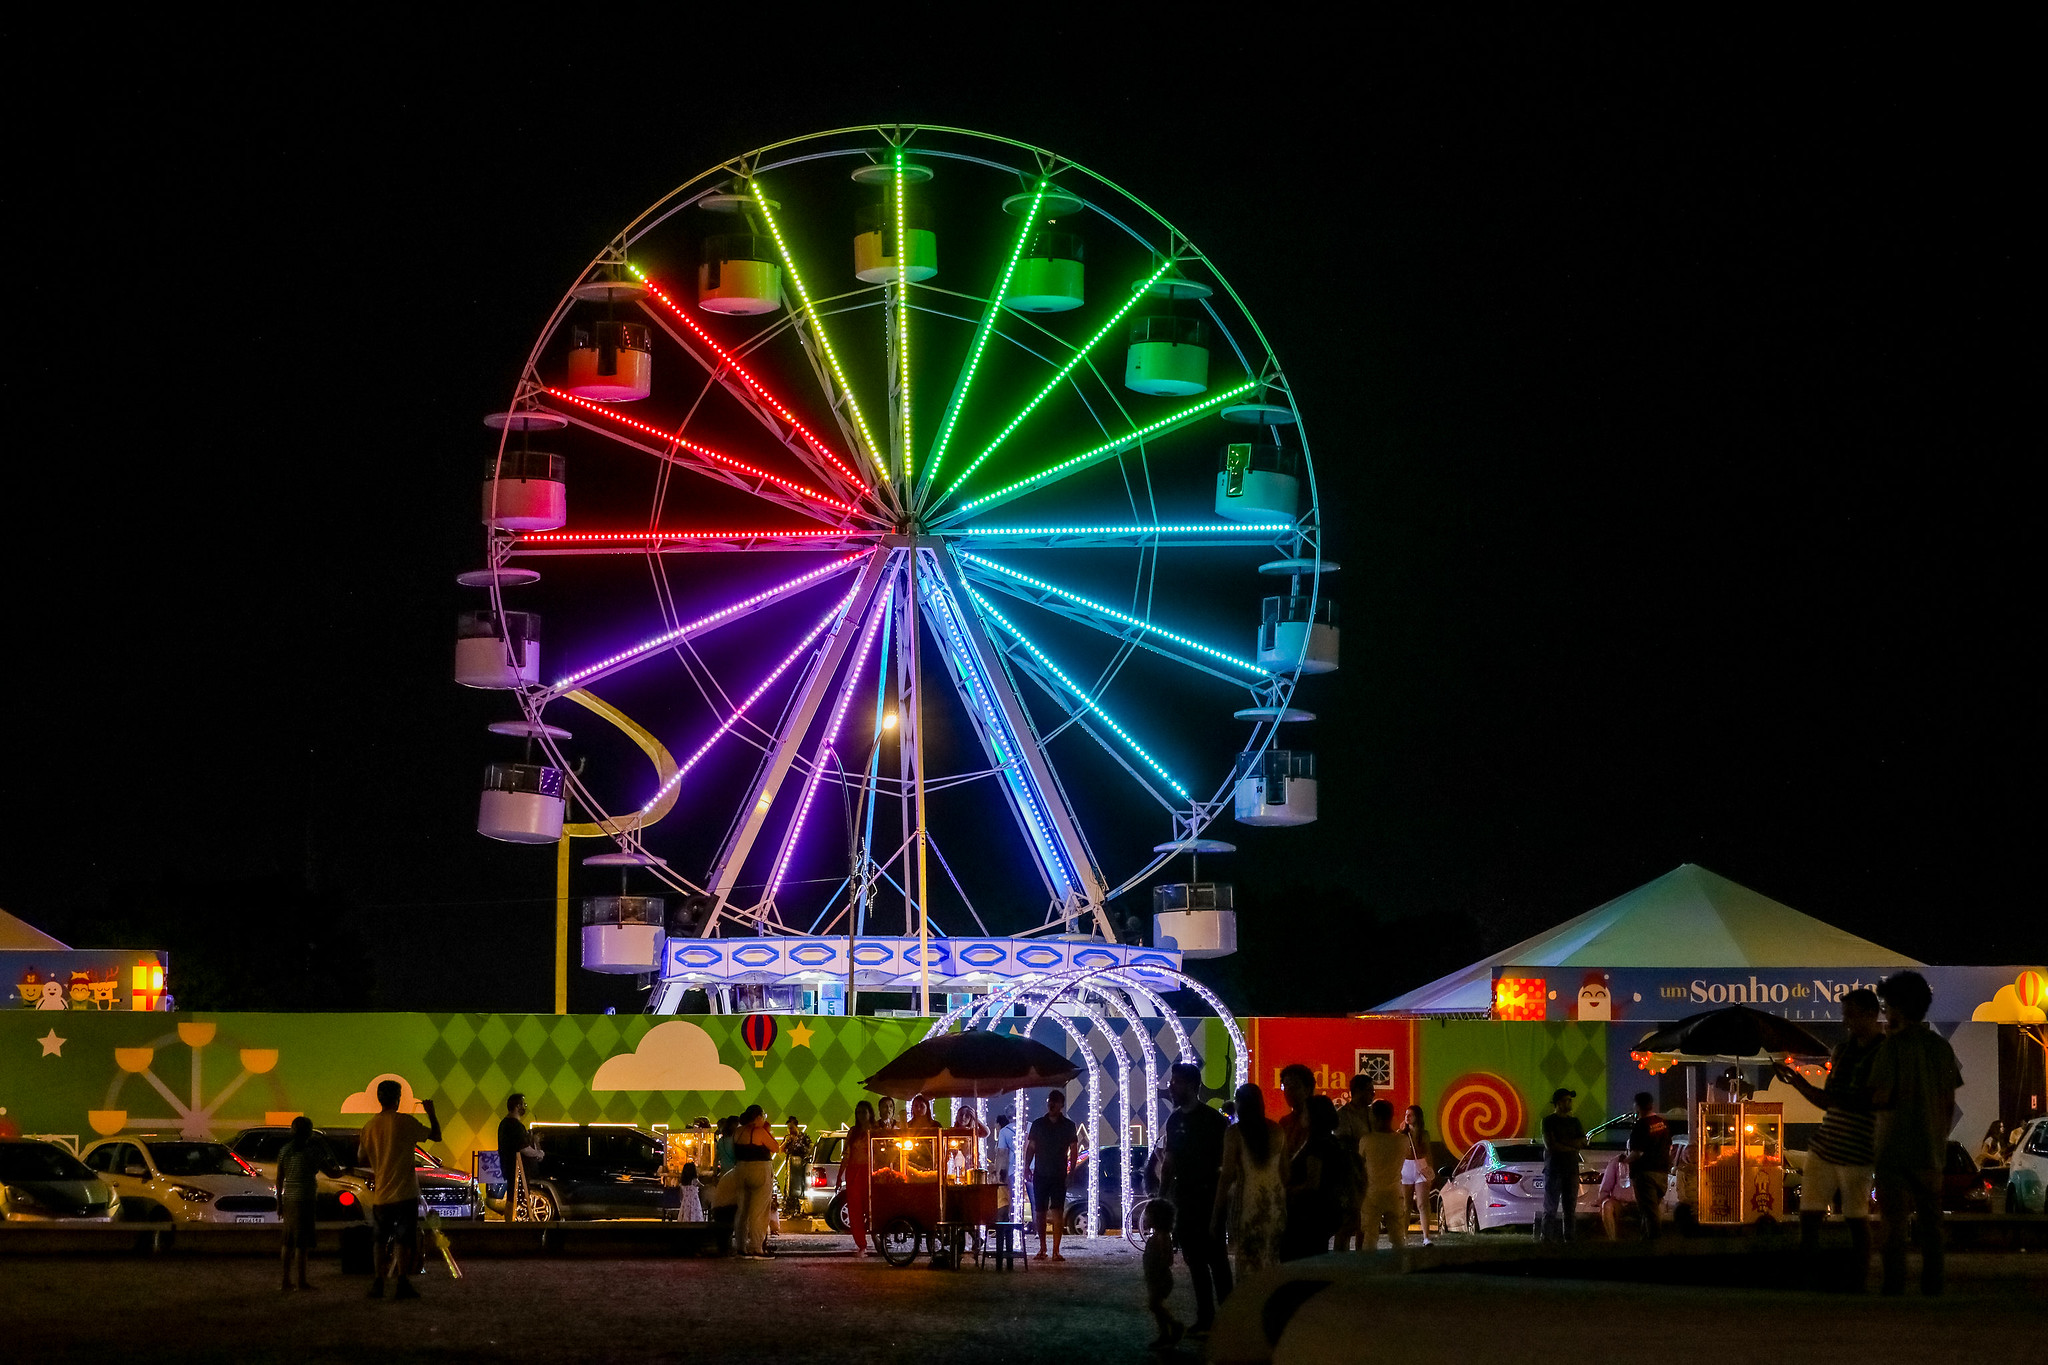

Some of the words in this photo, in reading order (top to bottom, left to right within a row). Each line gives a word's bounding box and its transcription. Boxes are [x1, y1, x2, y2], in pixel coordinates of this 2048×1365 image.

[1660, 985, 1687, 998] um
[1690, 976, 1789, 1004] Sonho
[1791, 983, 1811, 998] de
